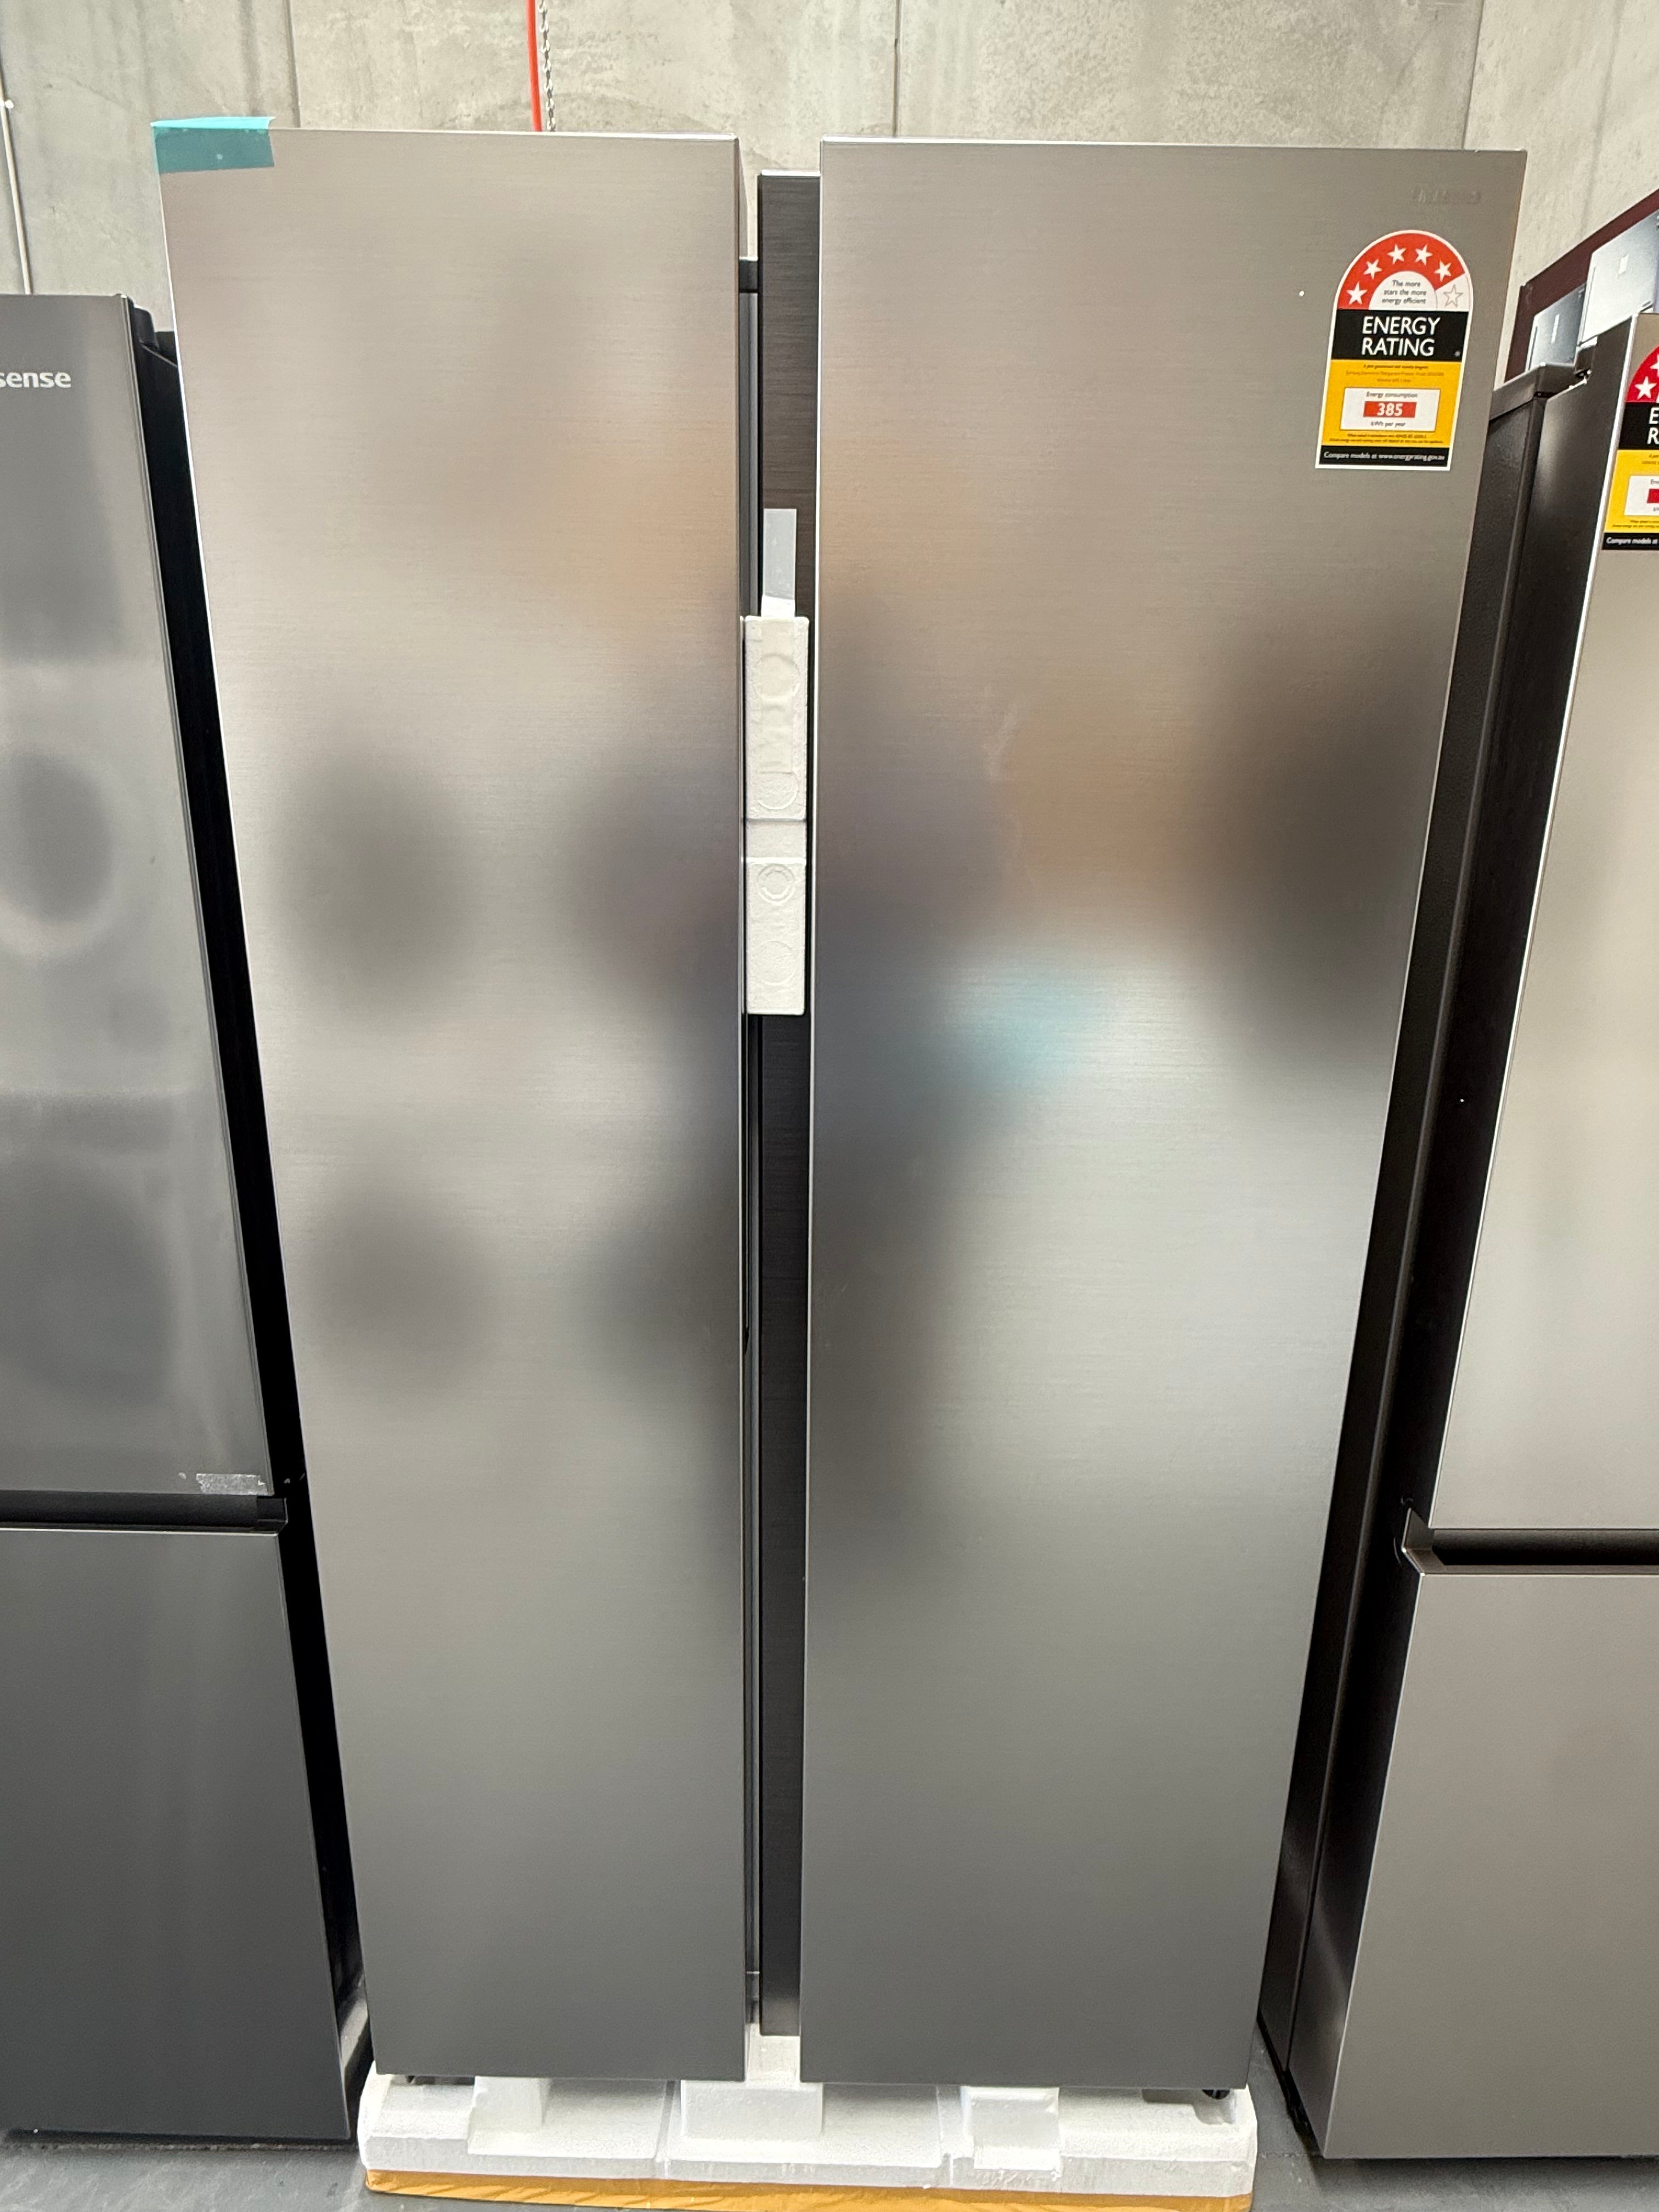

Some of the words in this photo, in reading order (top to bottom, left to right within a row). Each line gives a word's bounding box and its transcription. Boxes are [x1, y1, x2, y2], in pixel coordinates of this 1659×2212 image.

[1362, 316, 1441, 335] ENERGY
[1362, 337, 1435, 357] RATING
[1377, 403, 1403, 416] 385
